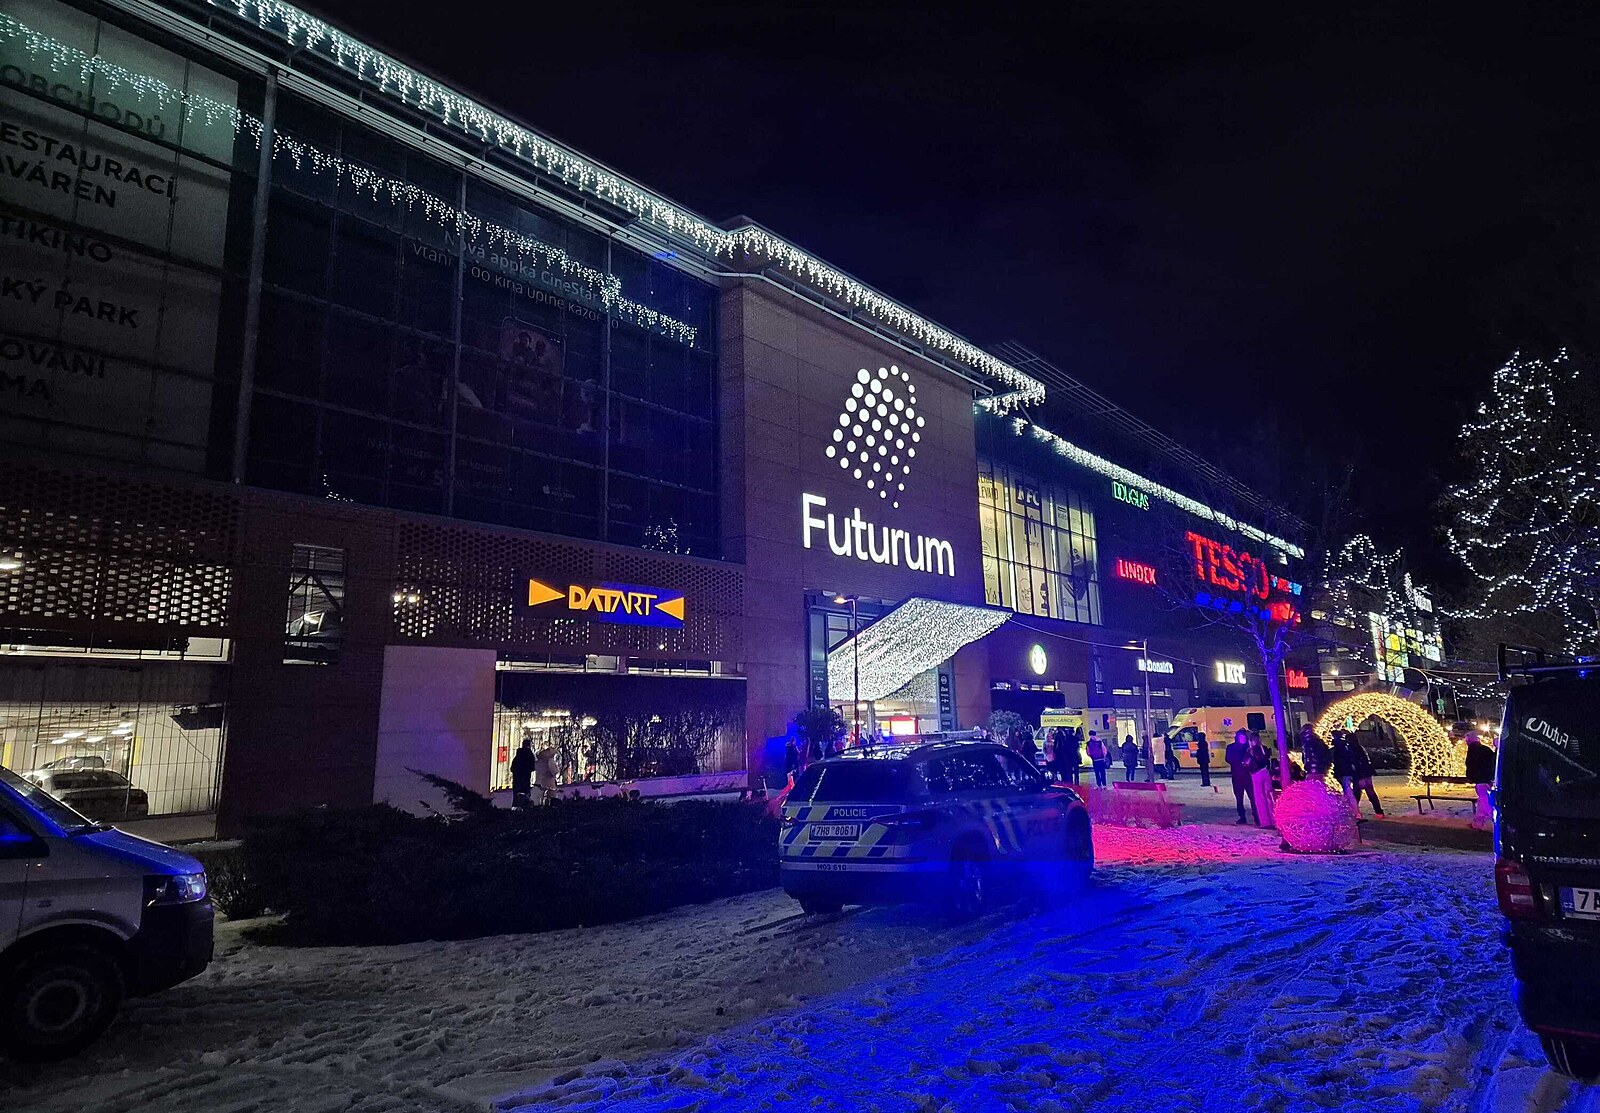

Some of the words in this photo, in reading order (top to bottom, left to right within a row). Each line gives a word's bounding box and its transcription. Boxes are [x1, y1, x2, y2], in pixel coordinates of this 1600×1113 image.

[55, 291, 138, 328] PARK
[1112, 480, 1150, 511] DOUGLAS
[802, 492, 955, 577] Futurum
[1118, 559, 1157, 585] LINDEX
[1186, 531, 1269, 600] TESCO
[568, 585, 658, 616] DATART
[1225, 662, 1247, 685] KFC
[833, 808, 867, 817] POLICIE
[835, 826, 854, 836] 8061
